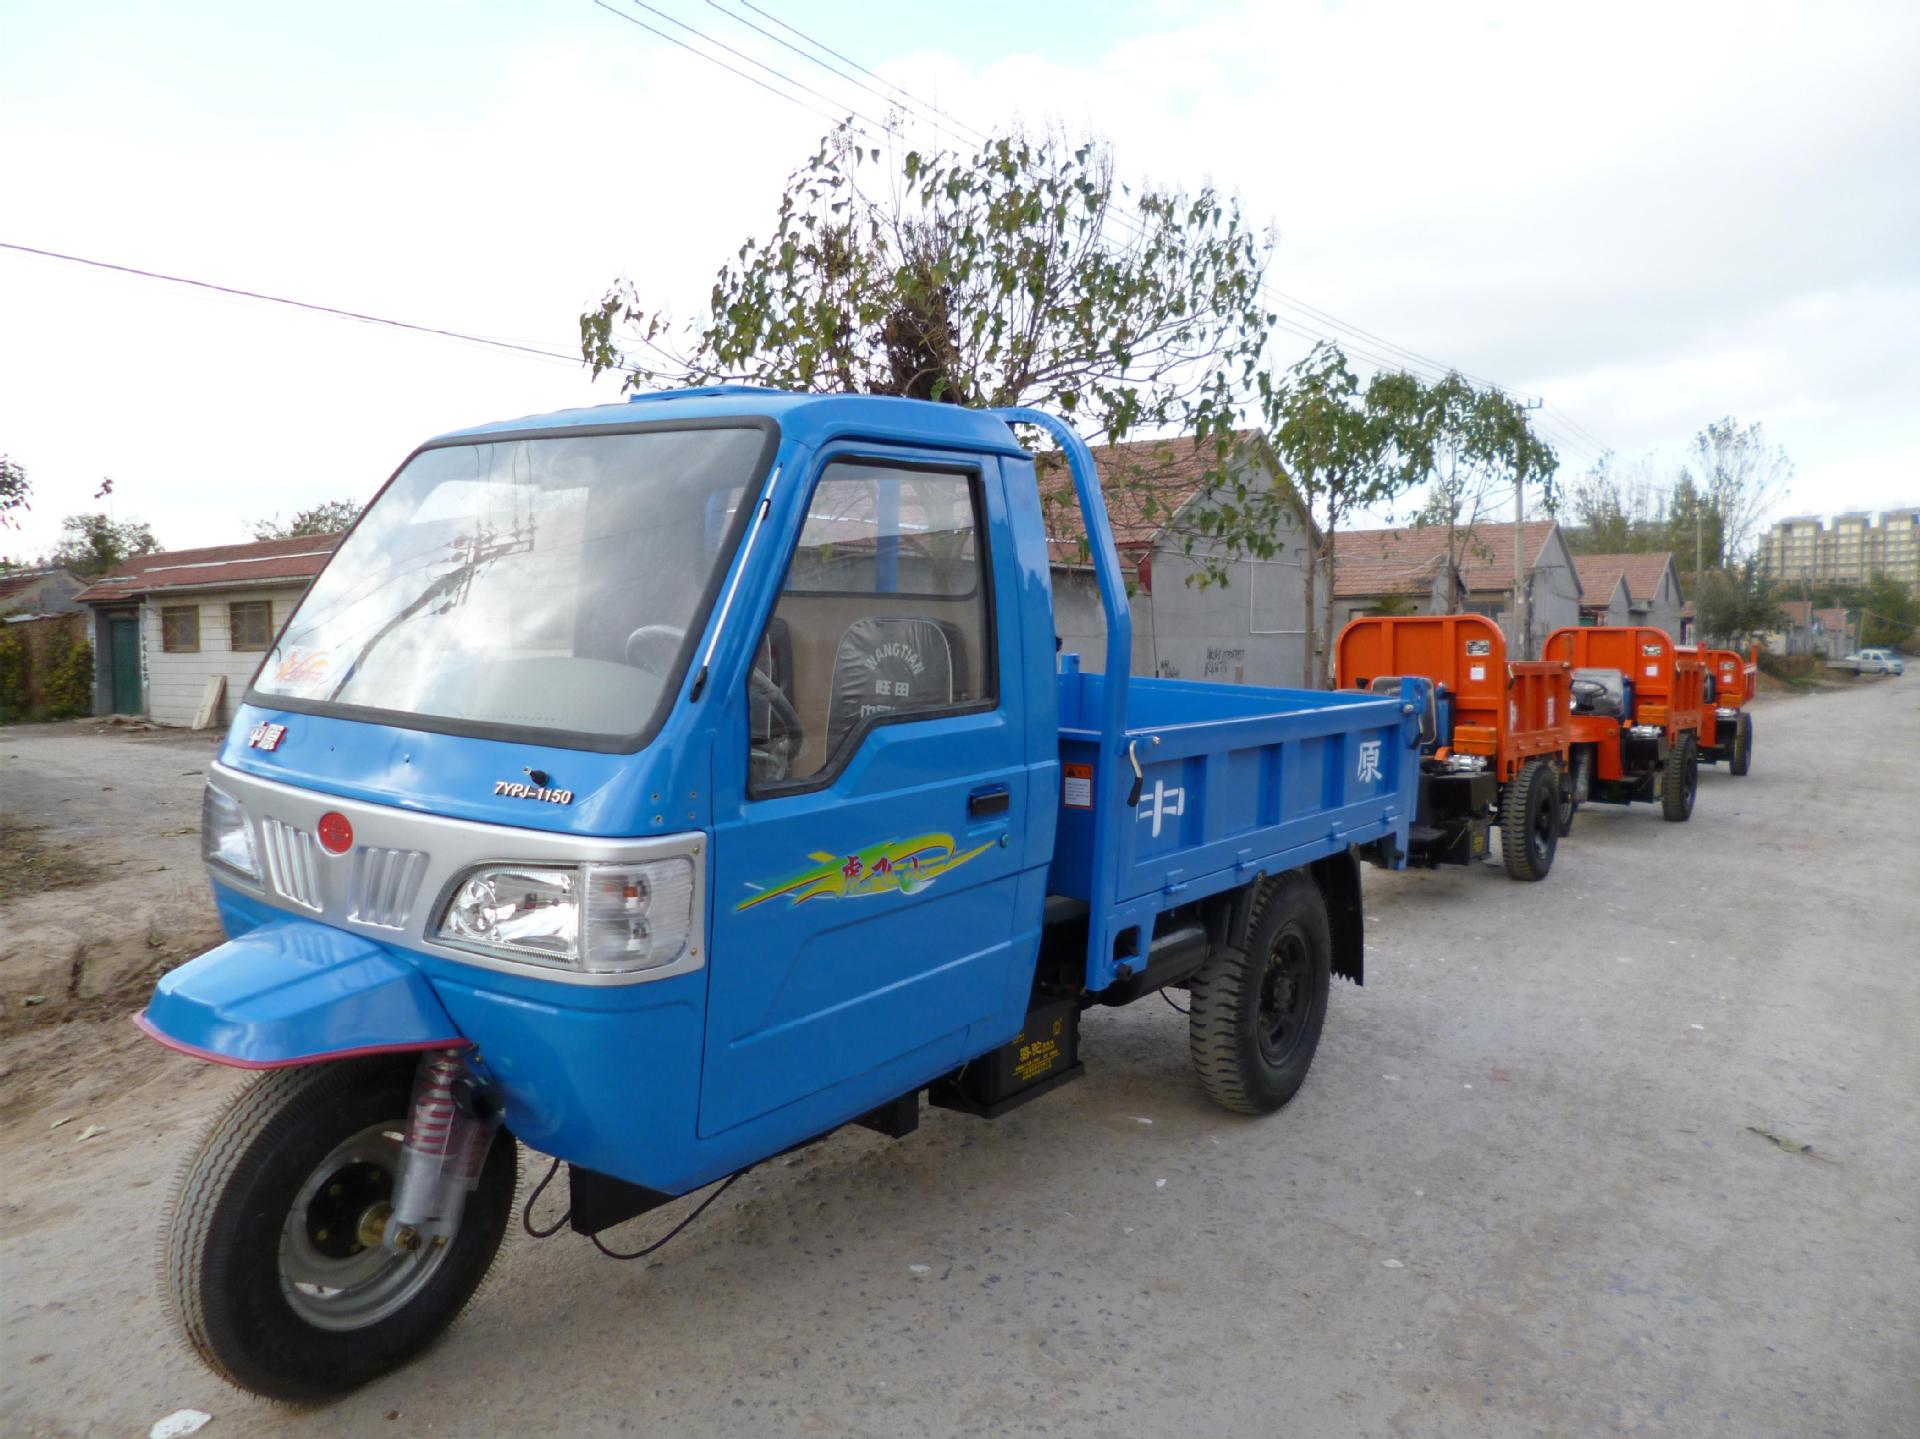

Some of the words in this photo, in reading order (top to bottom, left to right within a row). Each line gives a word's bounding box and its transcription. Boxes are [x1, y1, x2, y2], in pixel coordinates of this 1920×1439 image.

[864, 642, 925, 675] WANGTIAN
[494, 781, 574, 805] 7YPJ-1150
[1136, 779, 1185, 838] 中
[1358, 740, 1383, 783] 原
